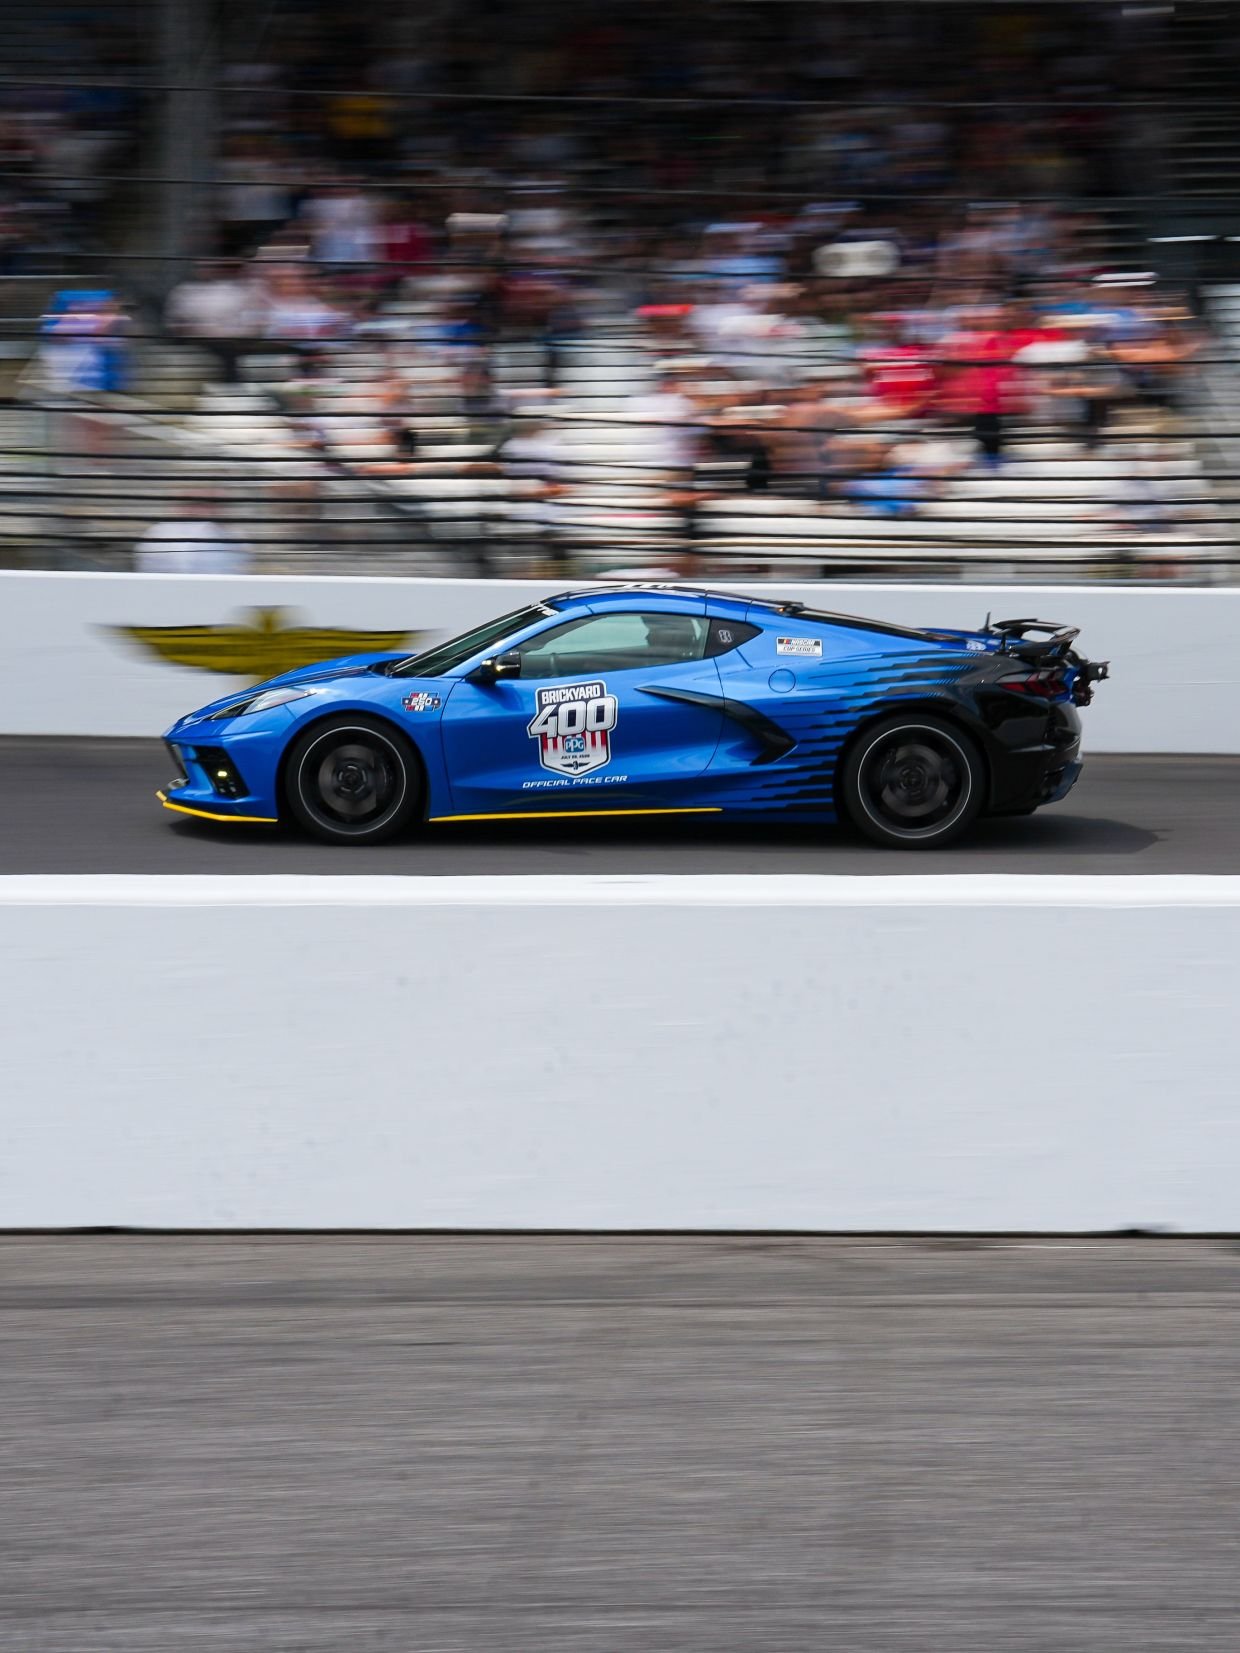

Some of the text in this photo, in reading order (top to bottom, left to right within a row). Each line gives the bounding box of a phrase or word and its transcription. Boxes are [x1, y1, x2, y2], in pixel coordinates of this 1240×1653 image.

[541, 685, 601, 705] BRICKYARD
[529, 696, 616, 739] 400
[565, 738, 585, 752] PPG
[522, 775, 628, 789] OFFICIAL PACE CAR
